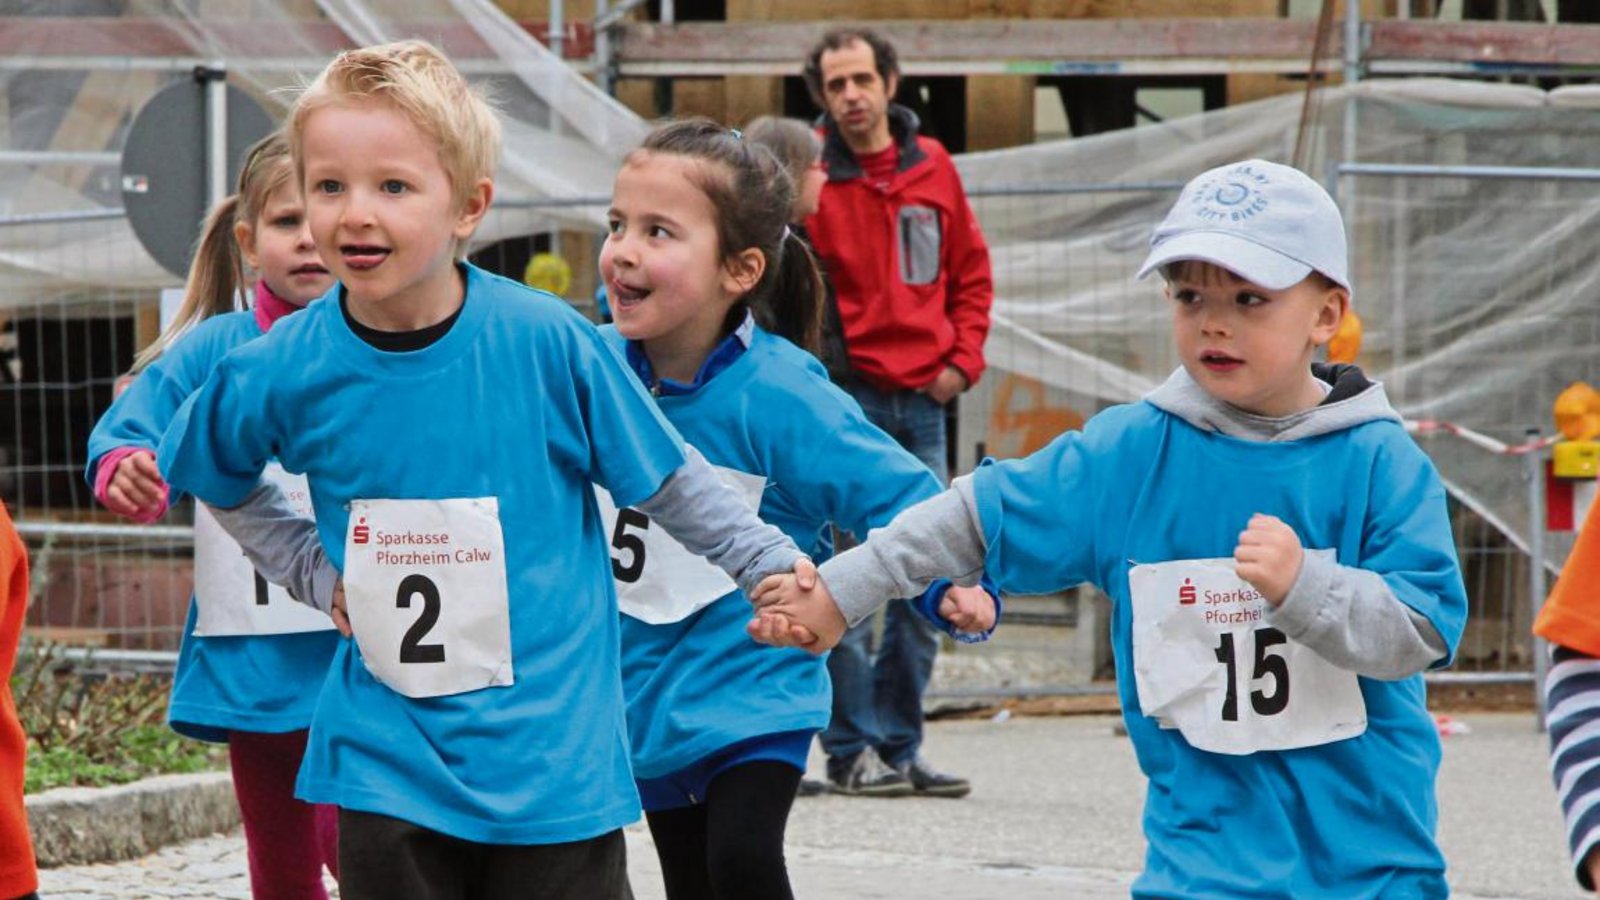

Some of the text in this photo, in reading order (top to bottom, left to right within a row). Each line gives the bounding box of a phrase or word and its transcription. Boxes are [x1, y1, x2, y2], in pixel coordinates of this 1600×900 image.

[1231, 198, 1269, 222] BIKES
[376, 531, 449, 547] Sparkasse
[611, 508, 649, 583] 5
[376, 548, 491, 565] Pforzheim Calw
[1204, 589, 1265, 606] Sparkas
[396, 574, 445, 663] 2
[1205, 605, 1263, 623] Pforzhei
[1214, 627, 1290, 721] 15
